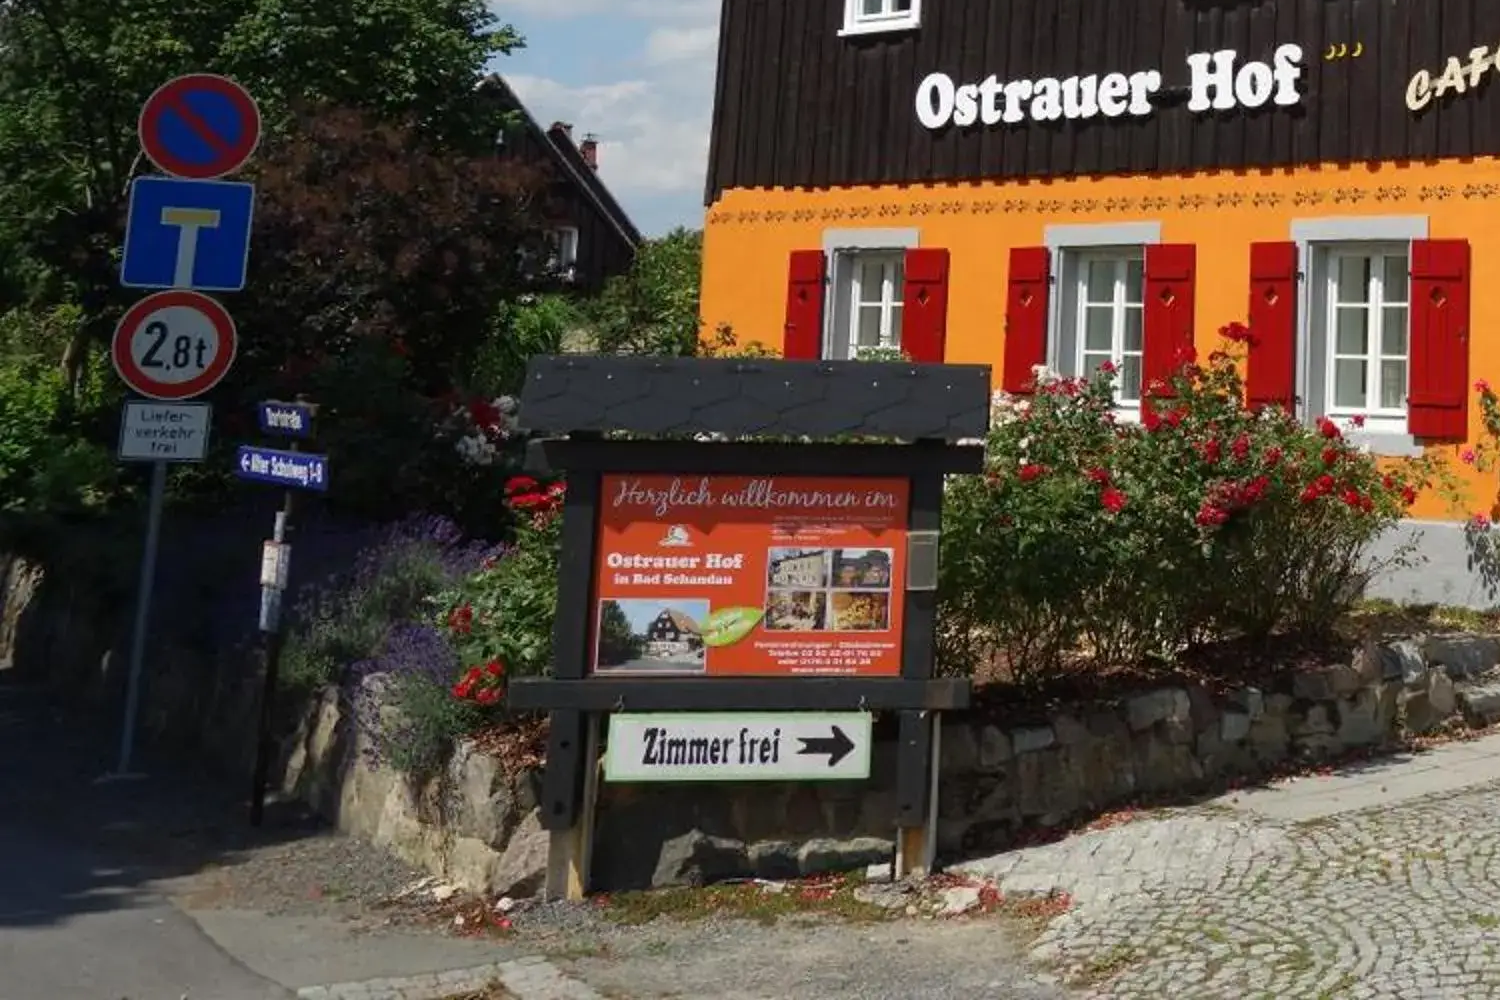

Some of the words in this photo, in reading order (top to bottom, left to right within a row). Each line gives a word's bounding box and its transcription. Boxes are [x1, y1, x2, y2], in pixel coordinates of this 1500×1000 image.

[916, 72, 1161, 128] Ostrauer
[1186, 44, 1303, 111] Hof
[613, 477, 717, 517] Herzlich
[721, 479, 860, 508] willkommen
[865, 490, 898, 507] im
[607, 552, 700, 569] Ostrauer
[705, 553, 744, 569] Hof
[614, 573, 628, 585] in
[633, 574, 661, 585] Bad
[663, 573, 733, 585] Schandau
[642, 728, 735, 765] Zimmer
[739, 727, 782, 764] frei
